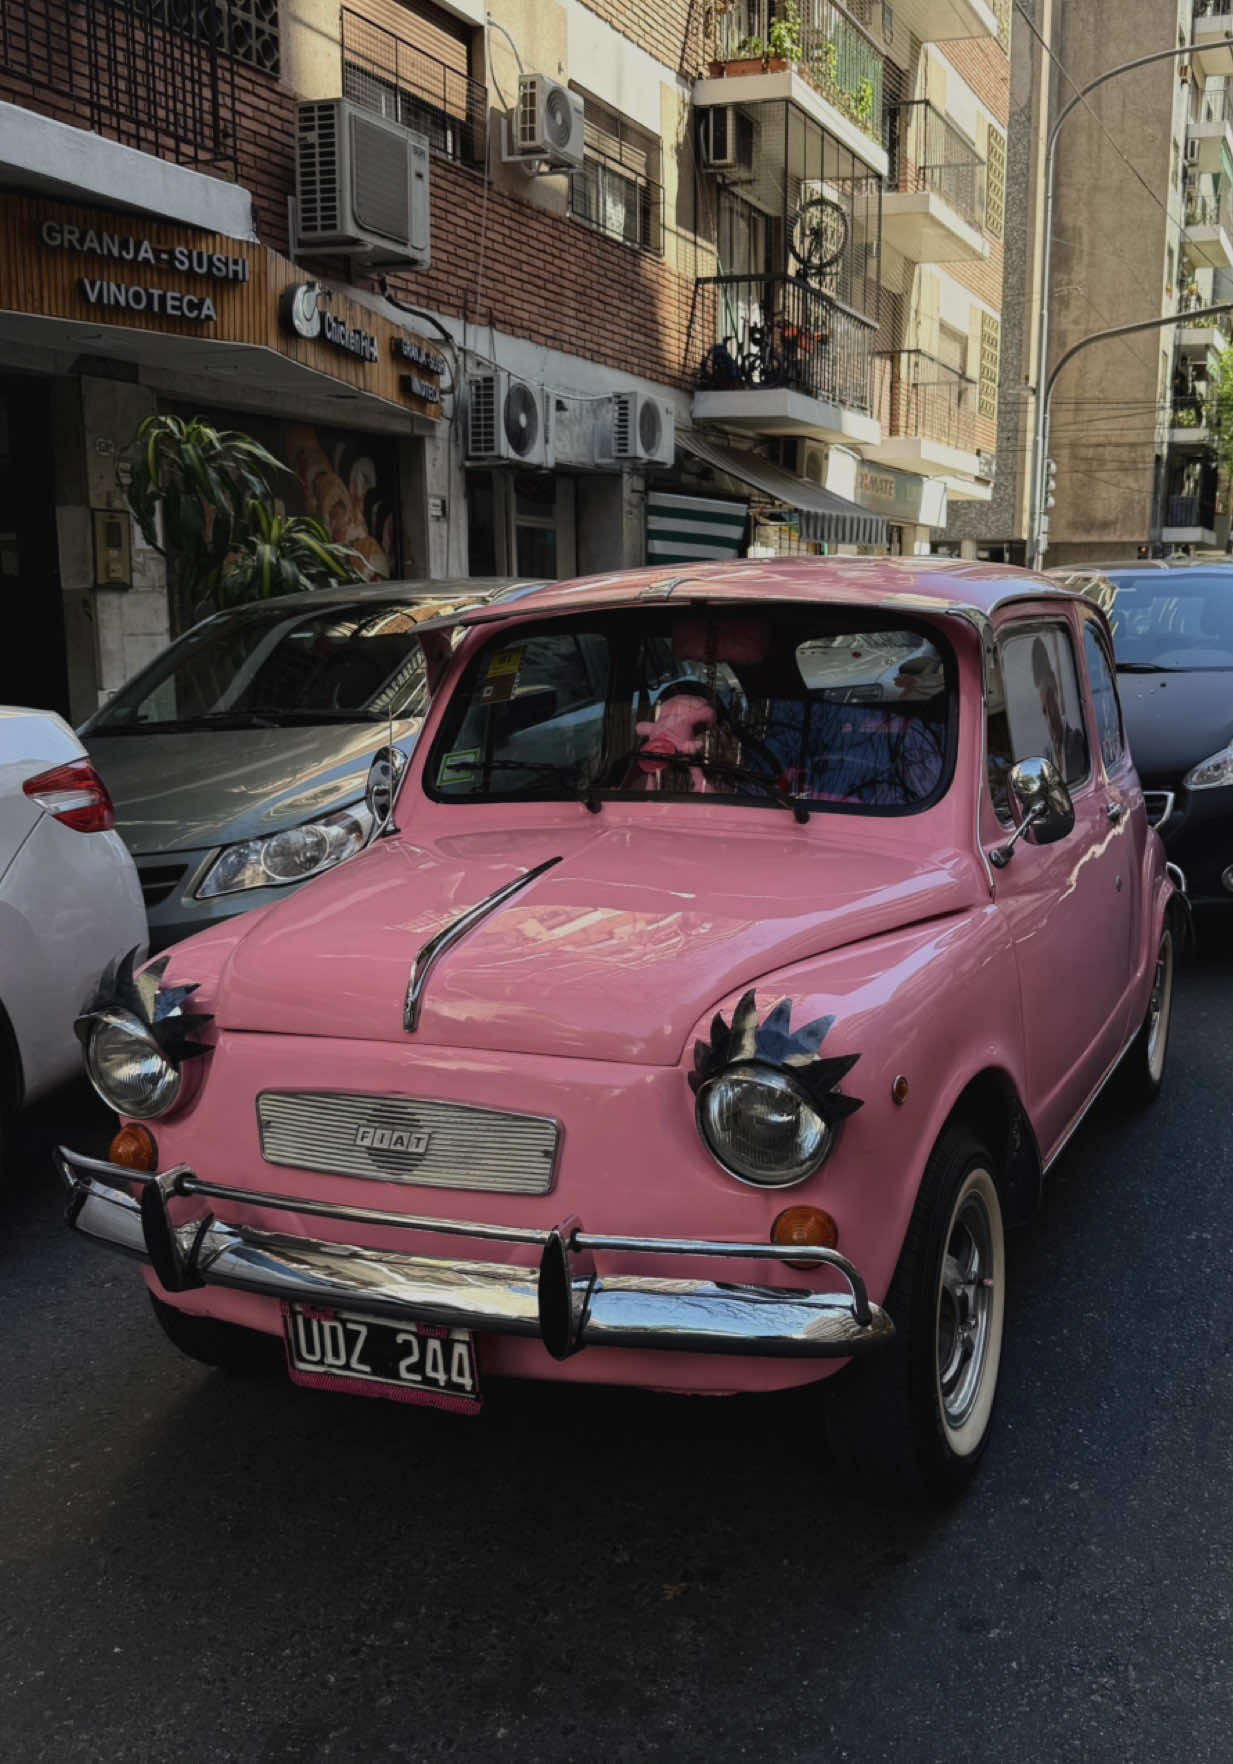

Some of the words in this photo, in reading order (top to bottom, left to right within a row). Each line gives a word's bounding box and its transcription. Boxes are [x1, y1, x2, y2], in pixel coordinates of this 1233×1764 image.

[41, 221, 156, 264] GRANJA
[173, 247, 250, 282] SUSHI
[82, 278, 217, 322] VINOTECA
[358, 1128, 426, 1150] FIAT
[296, 1312, 372, 1374] UDZ
[396, 1332, 473, 1391] 244
